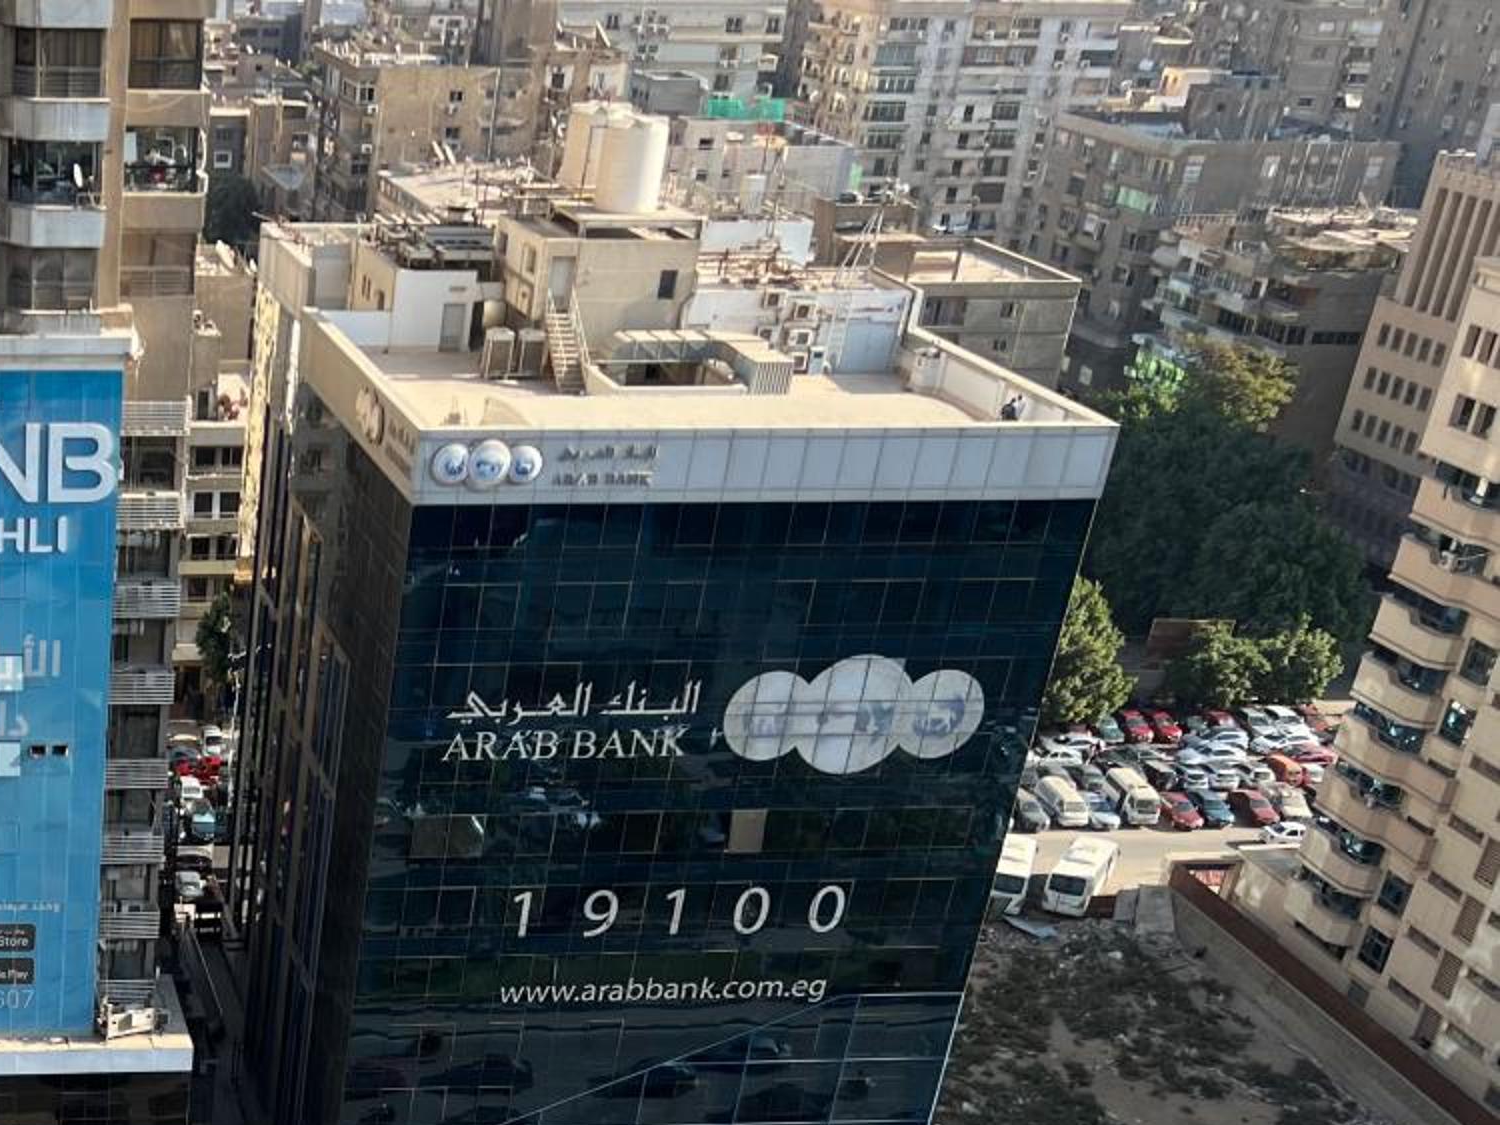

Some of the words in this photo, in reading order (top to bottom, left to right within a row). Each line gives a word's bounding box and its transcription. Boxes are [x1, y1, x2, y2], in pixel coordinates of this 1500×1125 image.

[600, 679, 702, 722] البنك
[441, 729, 559, 762] ARAB
[571, 728, 690, 758] BANK
[500, 977, 827, 1004] www.arabbank.com.eg
